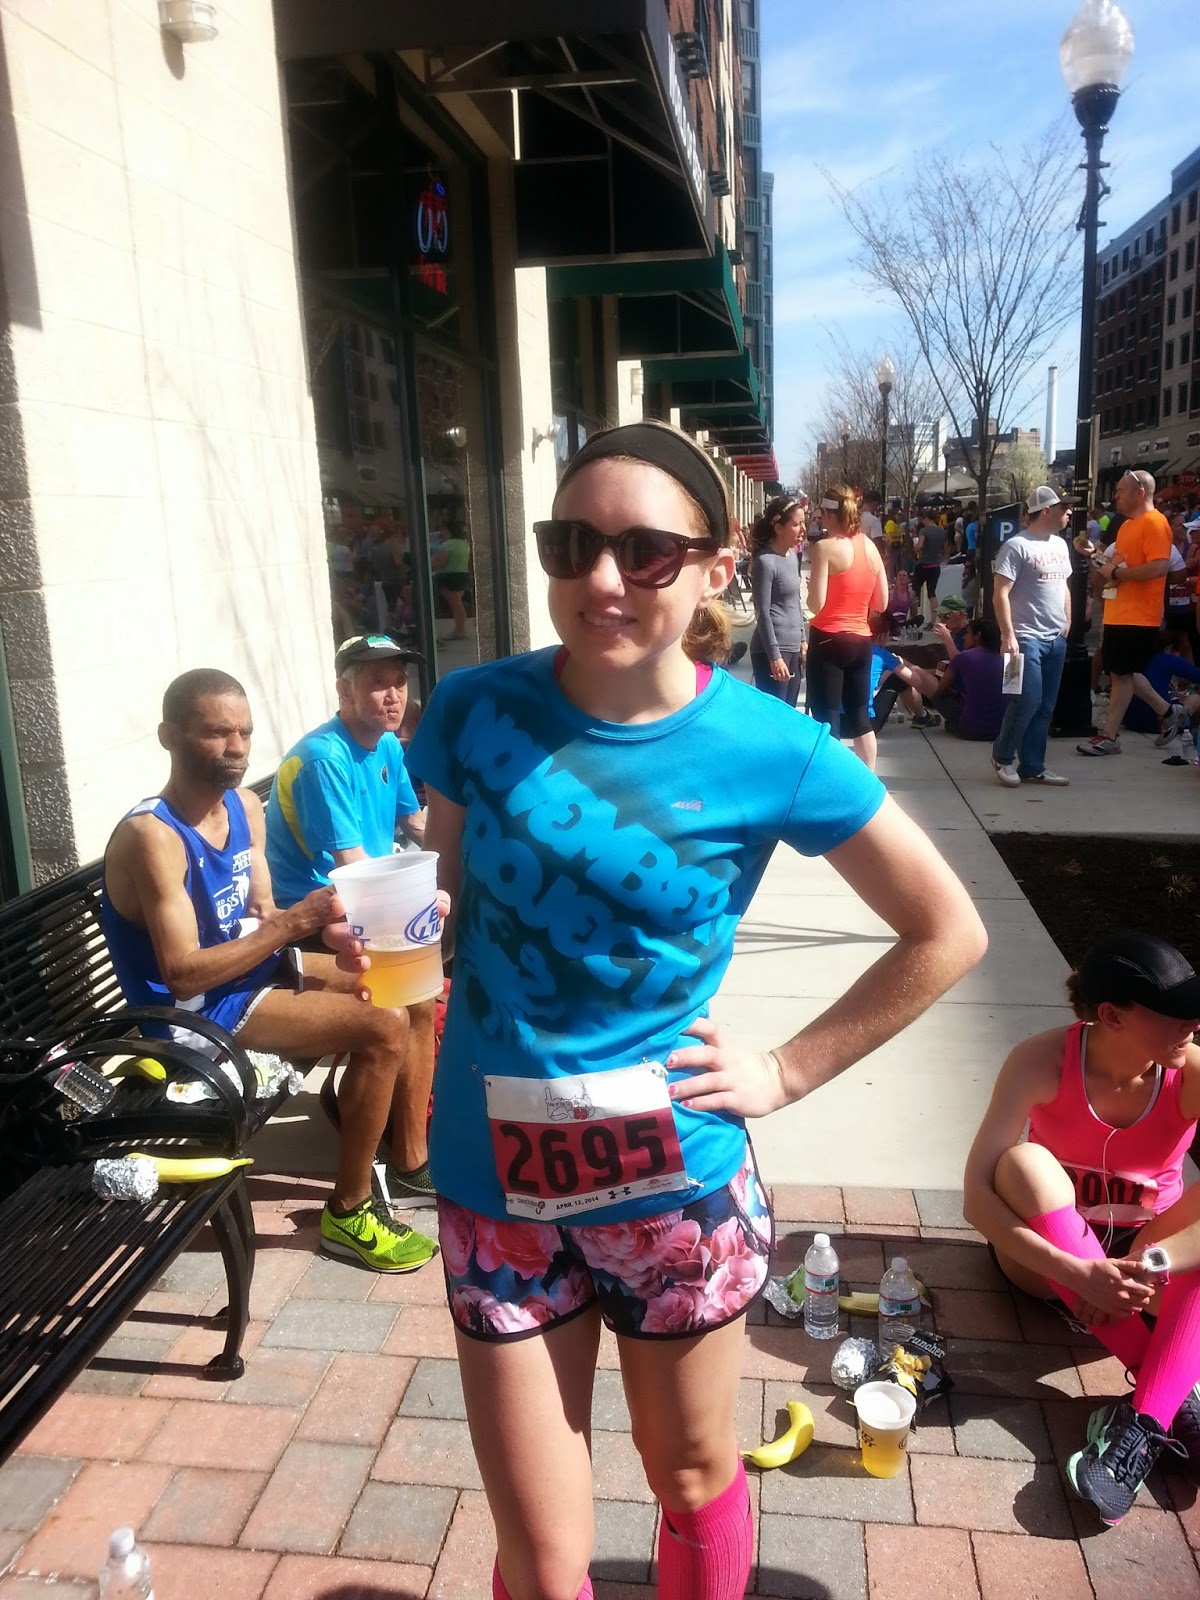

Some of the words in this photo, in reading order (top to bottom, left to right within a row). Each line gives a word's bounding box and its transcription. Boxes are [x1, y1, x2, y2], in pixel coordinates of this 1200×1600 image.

[1180, 475, 1196, 483] STOP
[1000, 521, 1014, 542] P
[500, 1117, 667, 1194] 2695
[556, 1202, 573, 1210] APRIL
